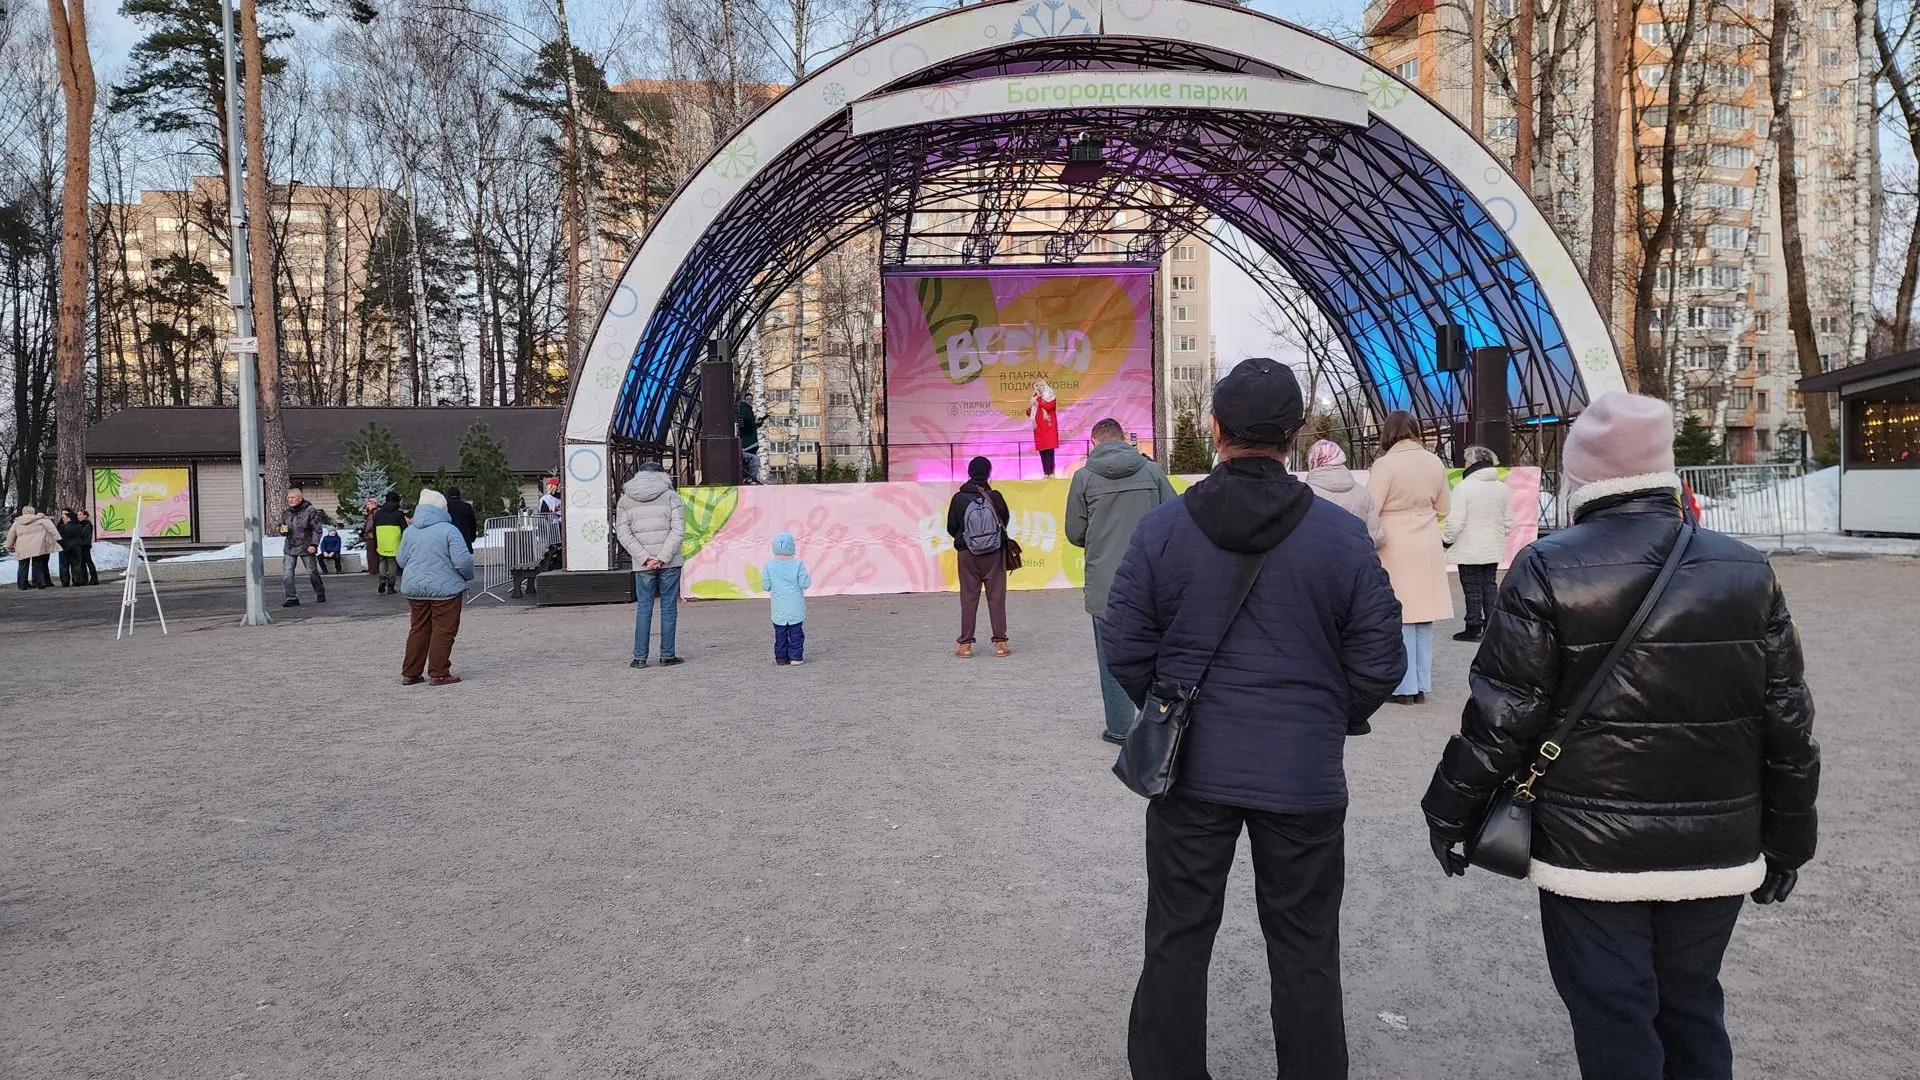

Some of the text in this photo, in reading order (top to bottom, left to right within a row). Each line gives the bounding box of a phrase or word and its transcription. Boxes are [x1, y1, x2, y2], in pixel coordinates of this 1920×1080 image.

[1007, 81, 1248, 104] Богородские парки
[1009, 371, 1048, 380] ПАРКАХ
[1000, 381, 1079, 391] ПОДМОКОВЬЯ
